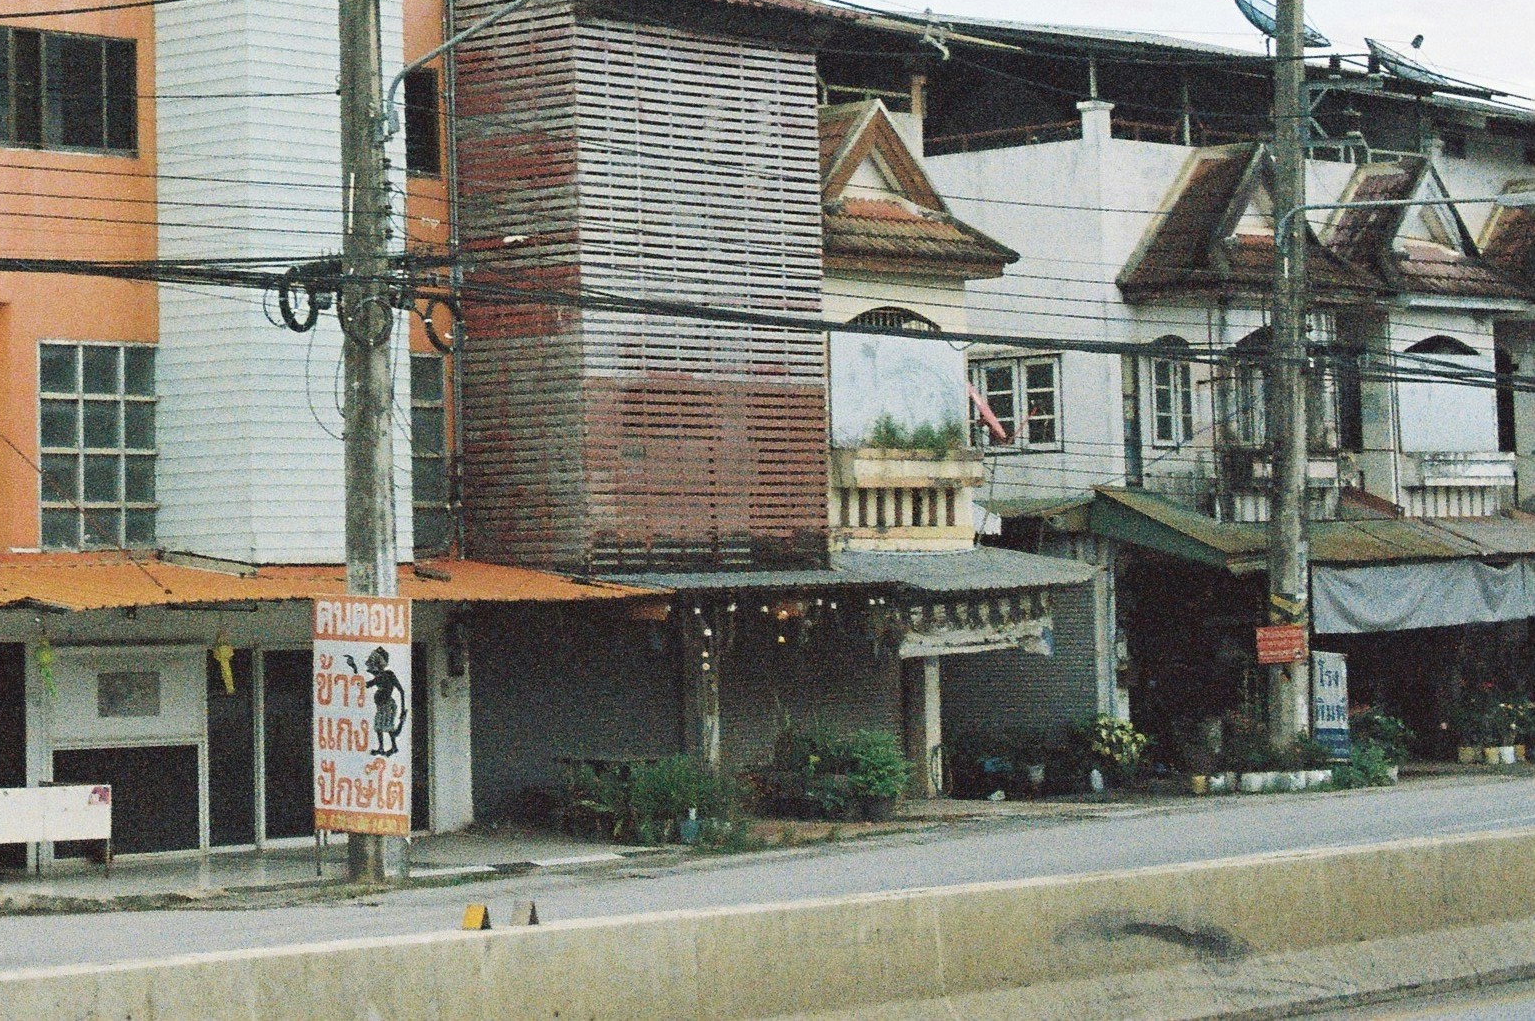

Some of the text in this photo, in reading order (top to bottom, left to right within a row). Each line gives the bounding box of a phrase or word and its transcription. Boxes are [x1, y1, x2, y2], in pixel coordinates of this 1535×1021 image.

[316, 653, 366, 708] ข้าว
[317, 716, 369, 752] แกง
[317, 757, 406, 811] ปักษ์ใต้
